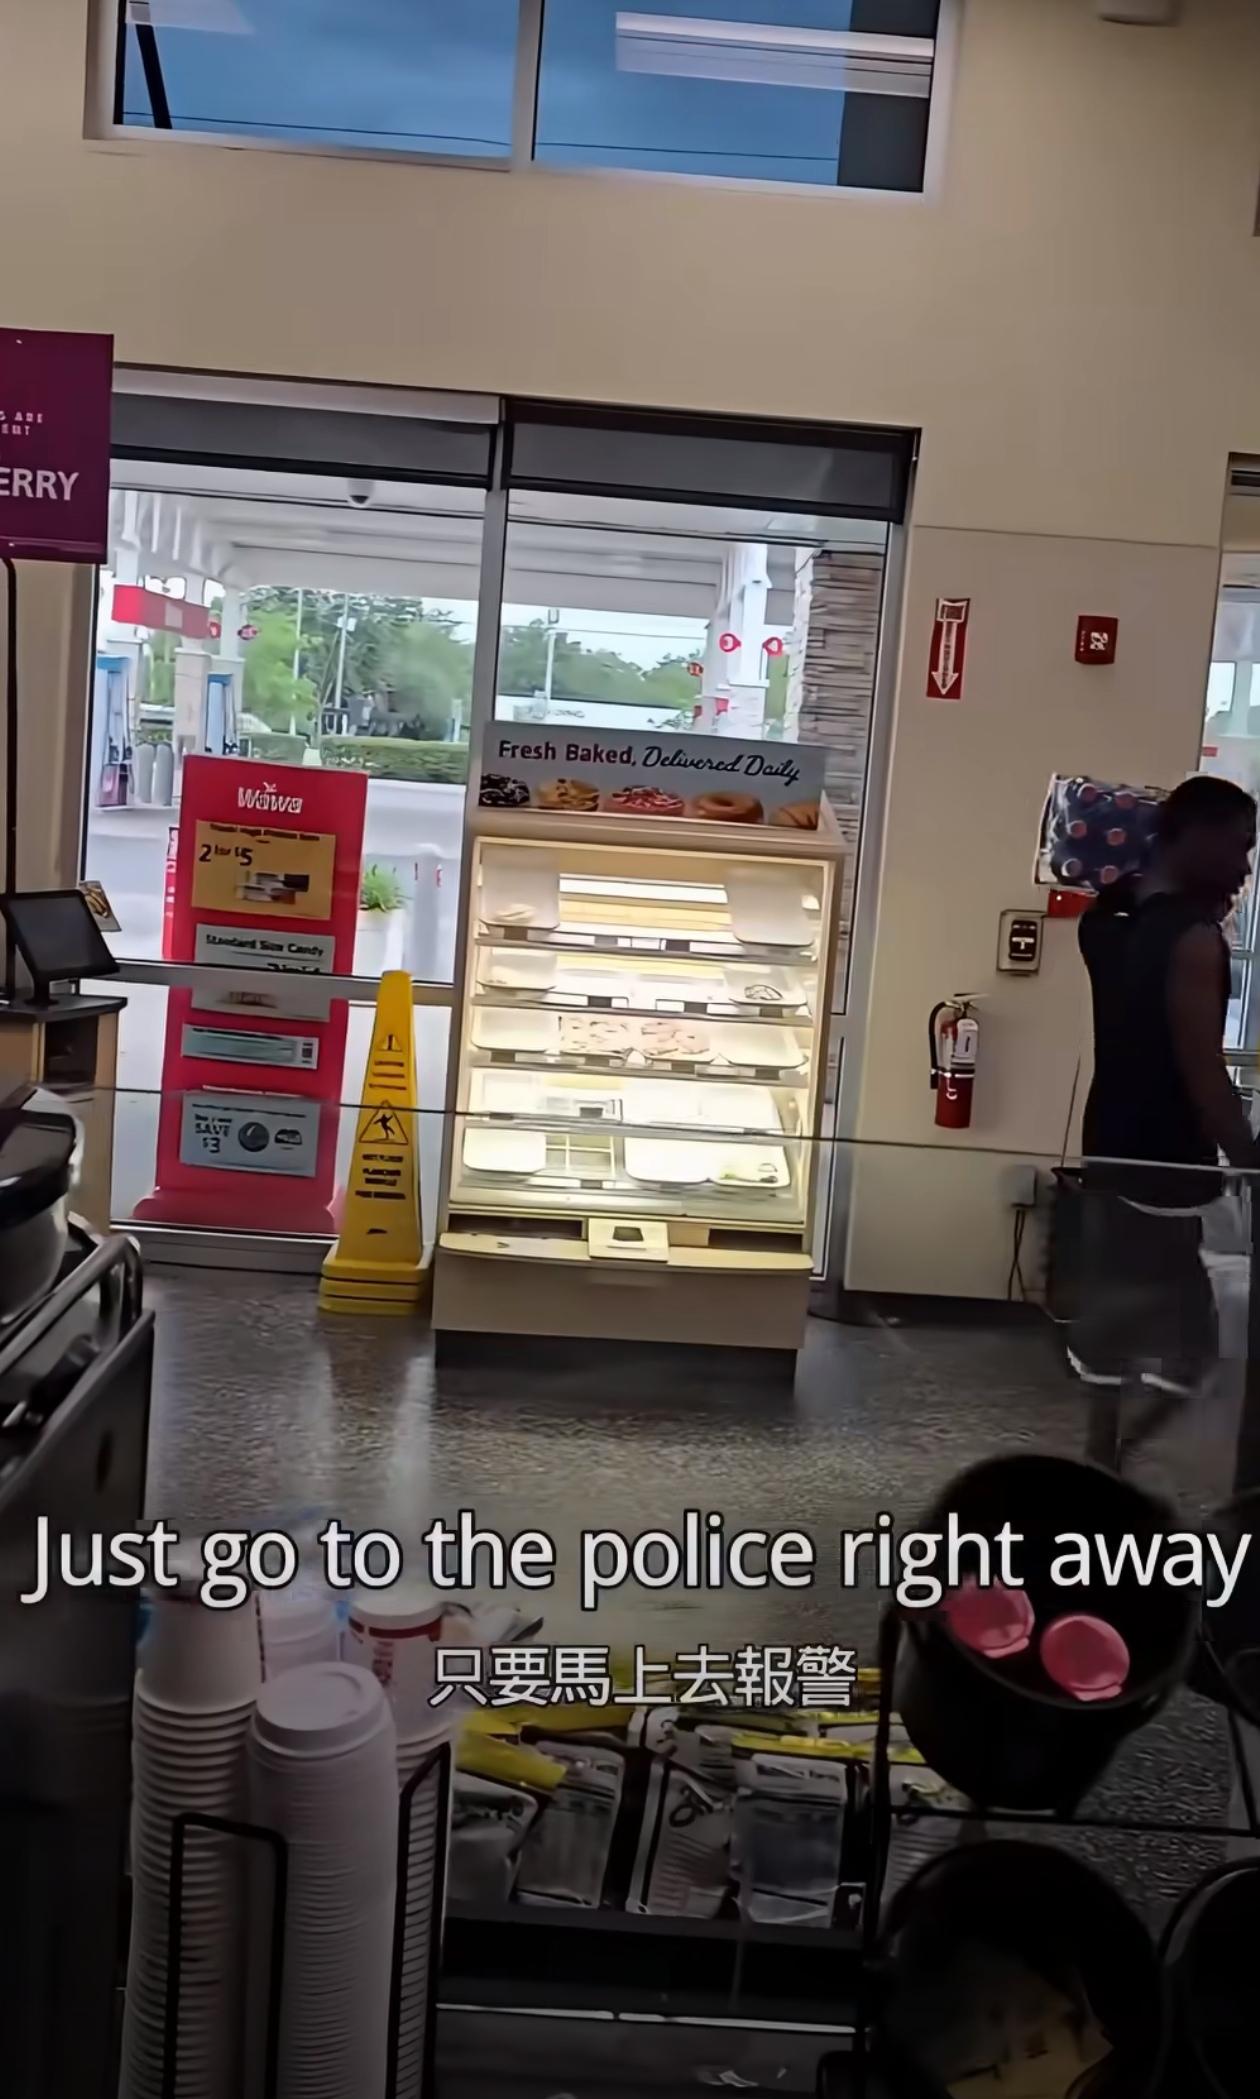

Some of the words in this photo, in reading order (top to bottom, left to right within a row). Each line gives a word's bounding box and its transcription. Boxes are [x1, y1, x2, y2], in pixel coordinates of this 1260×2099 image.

[498, 740, 557, 761] Fresh
[565, 743, 637, 767] Baked,
[642, 746, 743, 774] Delivered
[743, 754, 800, 787] Daily
[237, 785, 304, 814] Wawa
[198, 844, 212, 863] 2
